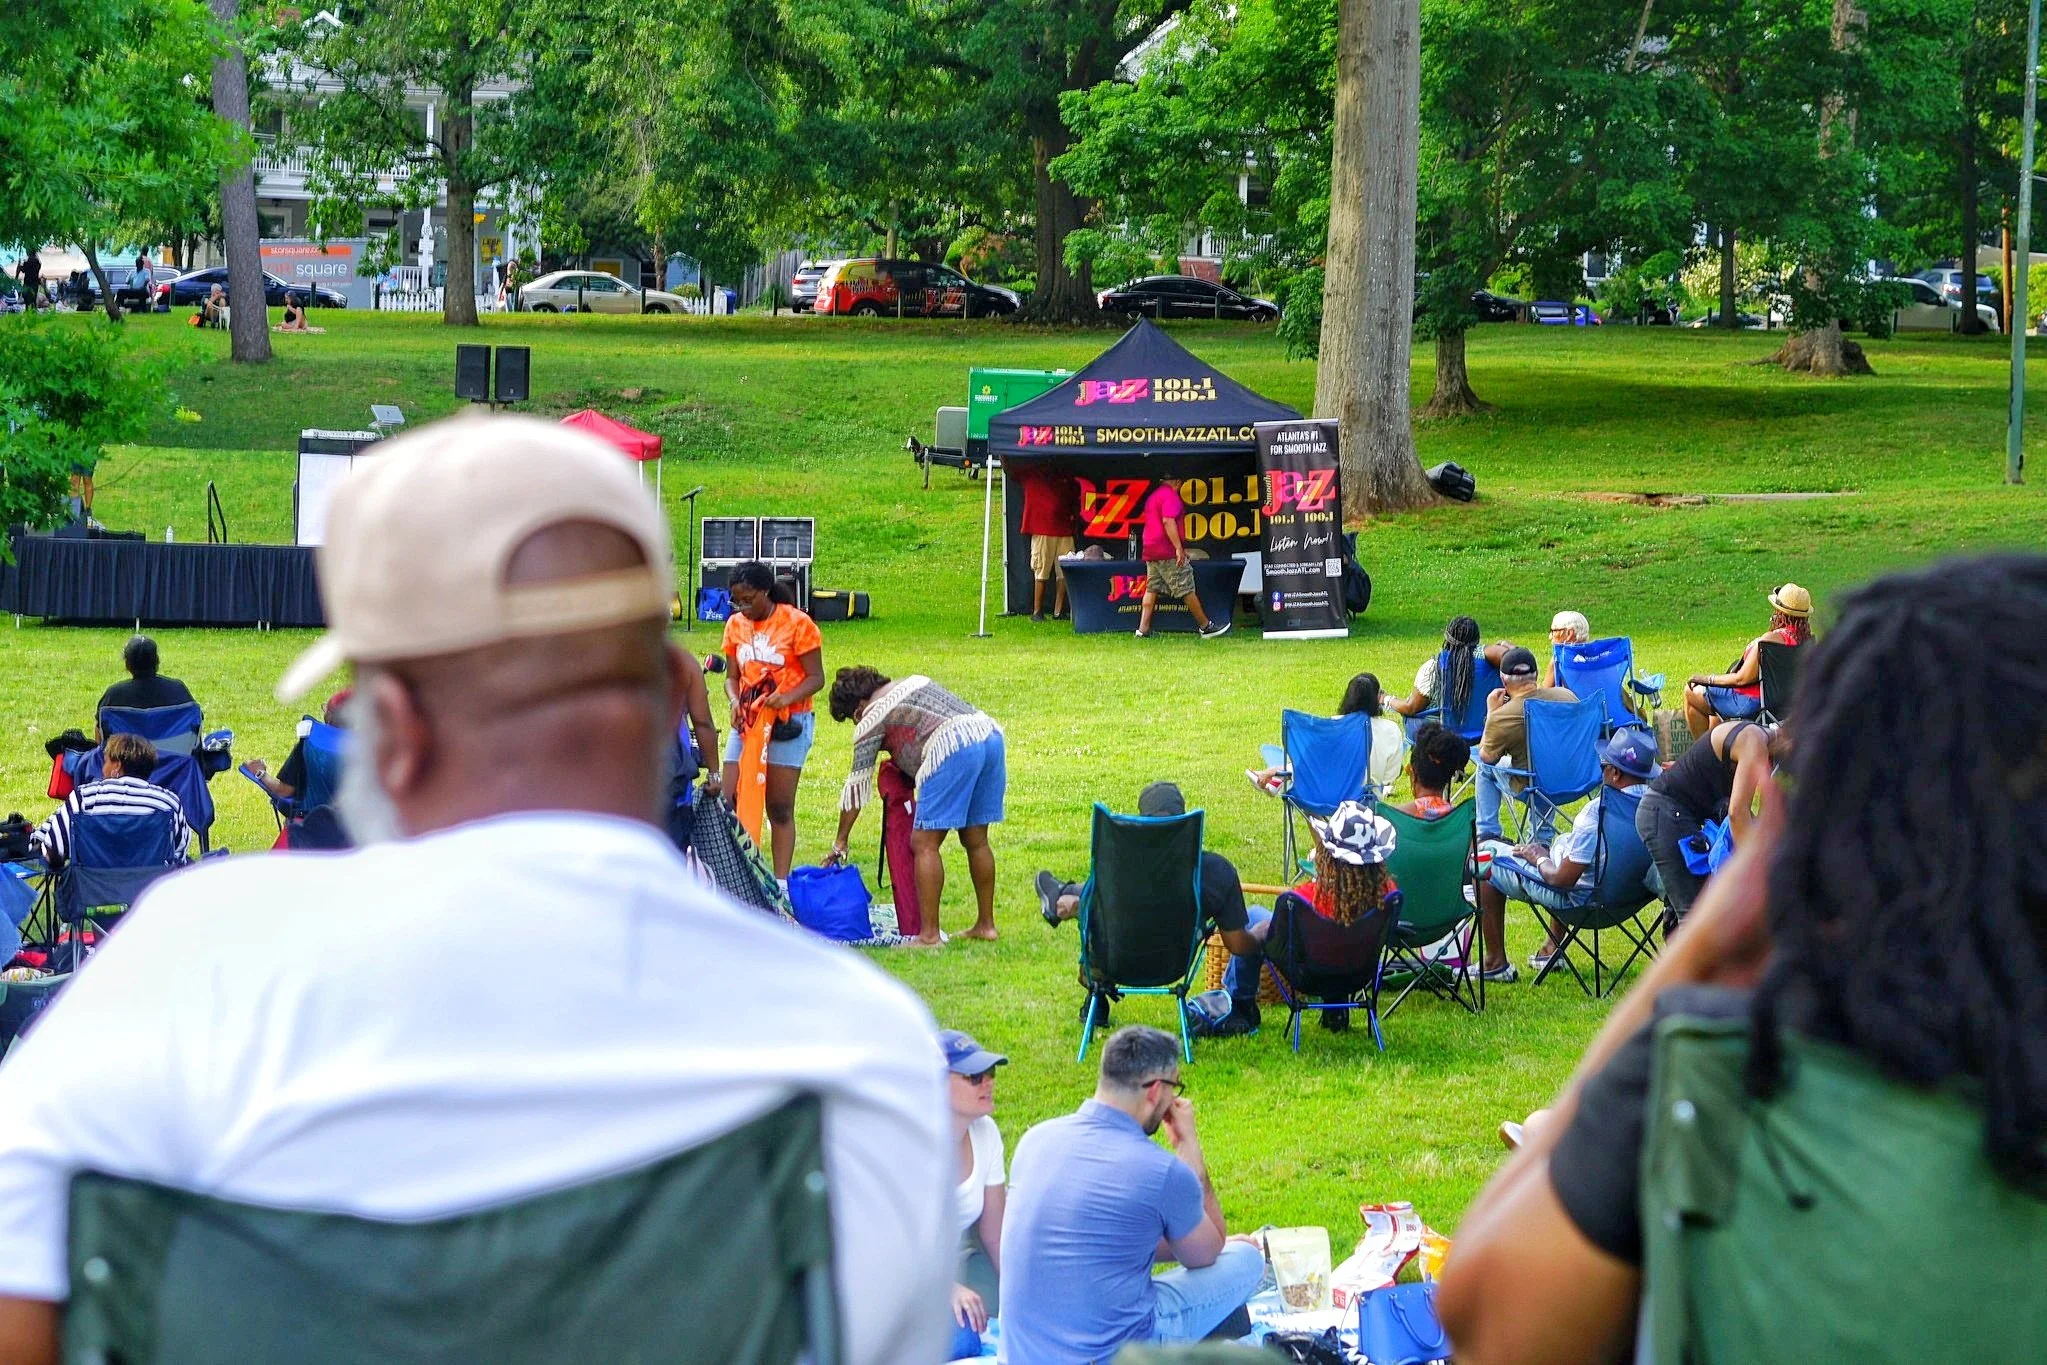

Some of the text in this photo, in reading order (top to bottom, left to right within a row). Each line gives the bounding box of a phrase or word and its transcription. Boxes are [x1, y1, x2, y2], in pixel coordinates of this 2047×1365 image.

[296, 262, 348, 278] square
[1153, 377, 1213, 390] 101.1
[1154, 389, 1217, 402] 100.1
[1054, 426, 1083, 435] 101.1
[1277, 430, 1318, 442] ATLANTA'S #1
[1054, 435, 1085, 445] 100.1
[1270, 443, 1327, 455] FOR SMOOTH JAZZ
[1180, 474, 1259, 505] 01.1
[1270, 512, 1334, 524] 101.1 100.1
[1184, 508, 1261, 541] 00.1
[1270, 536, 1298, 552] Listen
[1671, 731, 1693, 741] WHA
